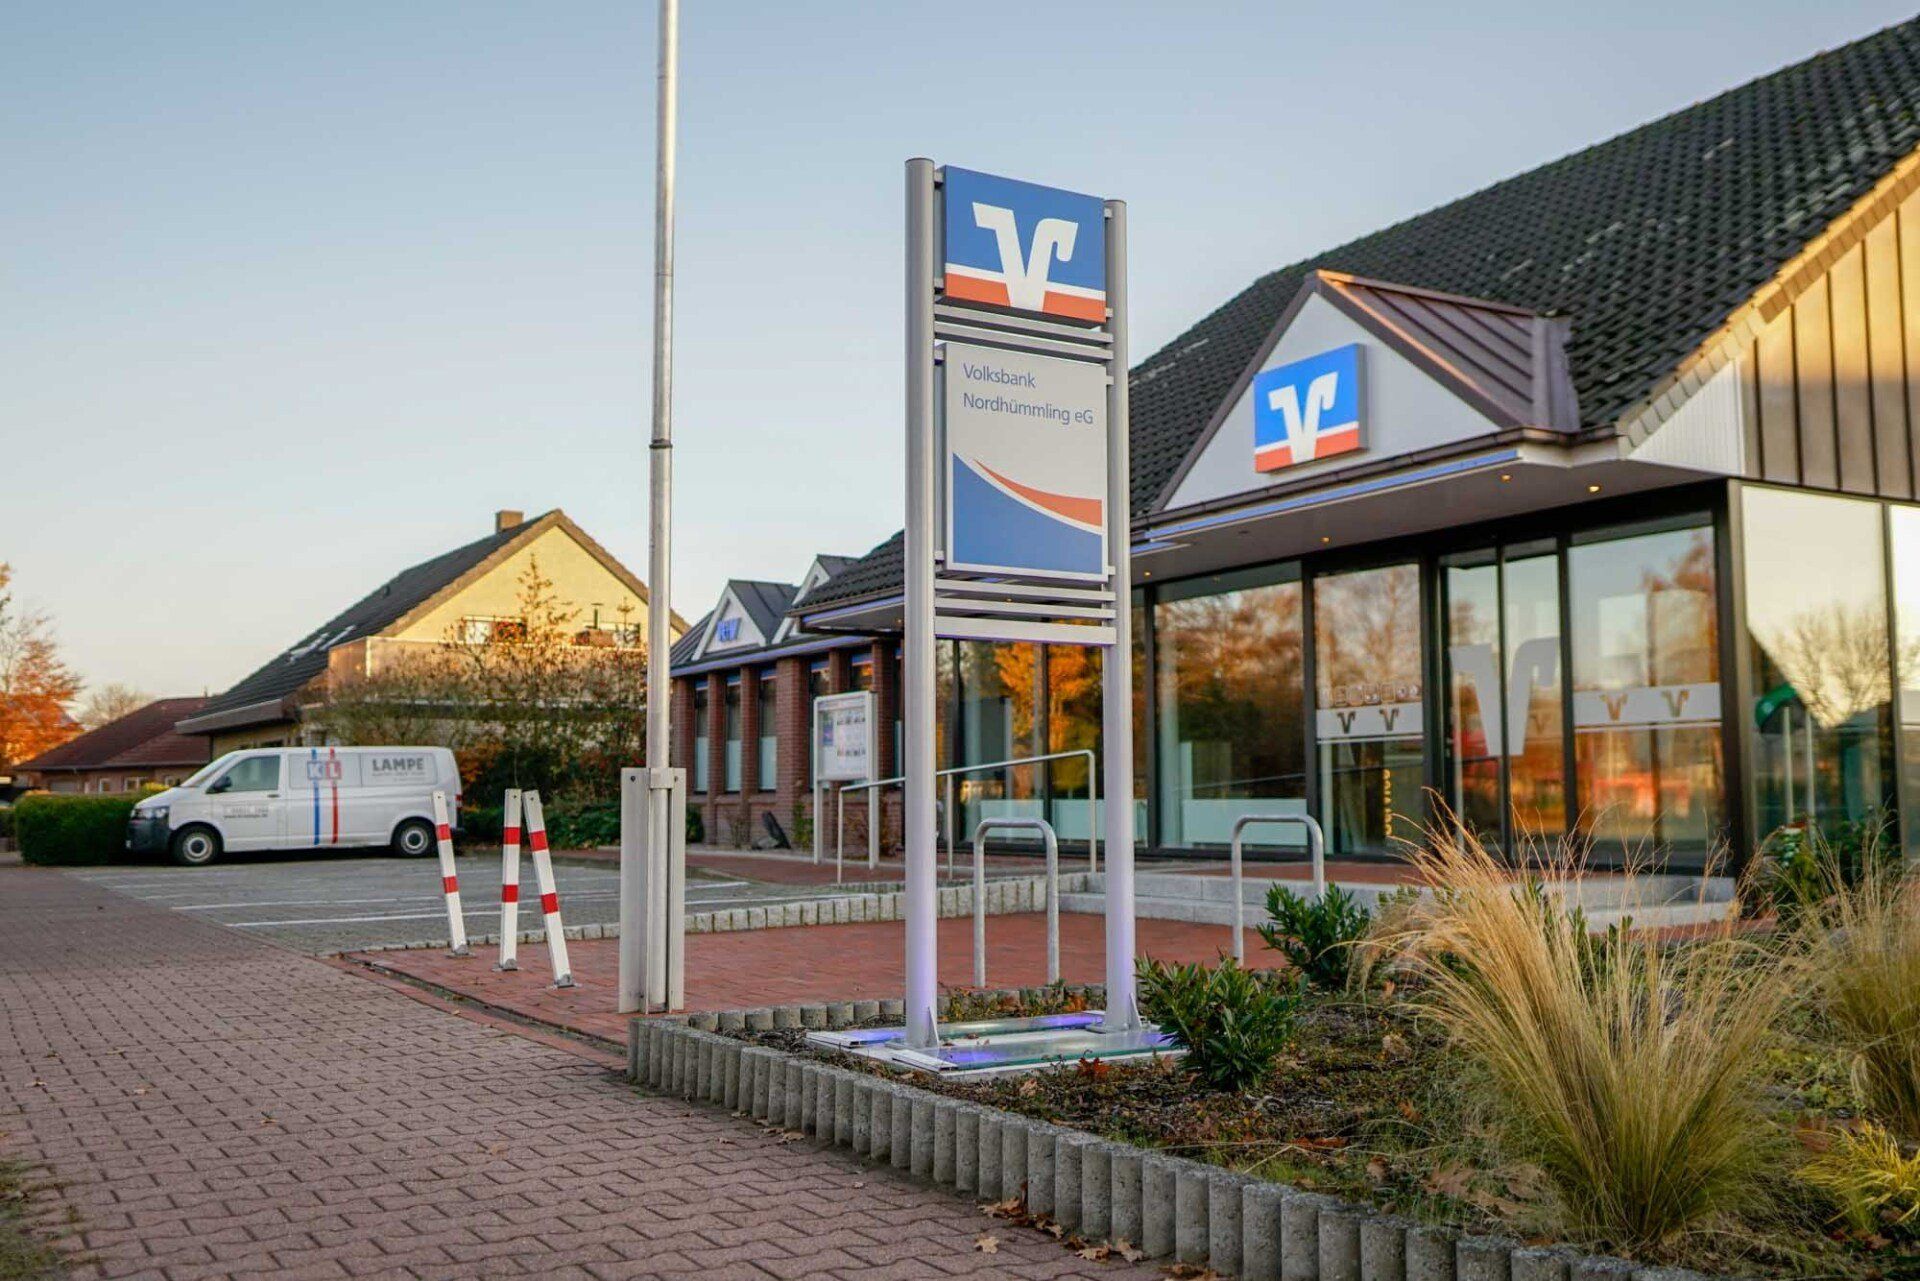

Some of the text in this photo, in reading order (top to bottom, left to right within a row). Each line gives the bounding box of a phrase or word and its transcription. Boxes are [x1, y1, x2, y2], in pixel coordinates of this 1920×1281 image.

[962, 363, 1036, 389] Volksbank
[963, 393, 1094, 425] Nordhümmling eG
[372, 757, 424, 772] LAMPE
